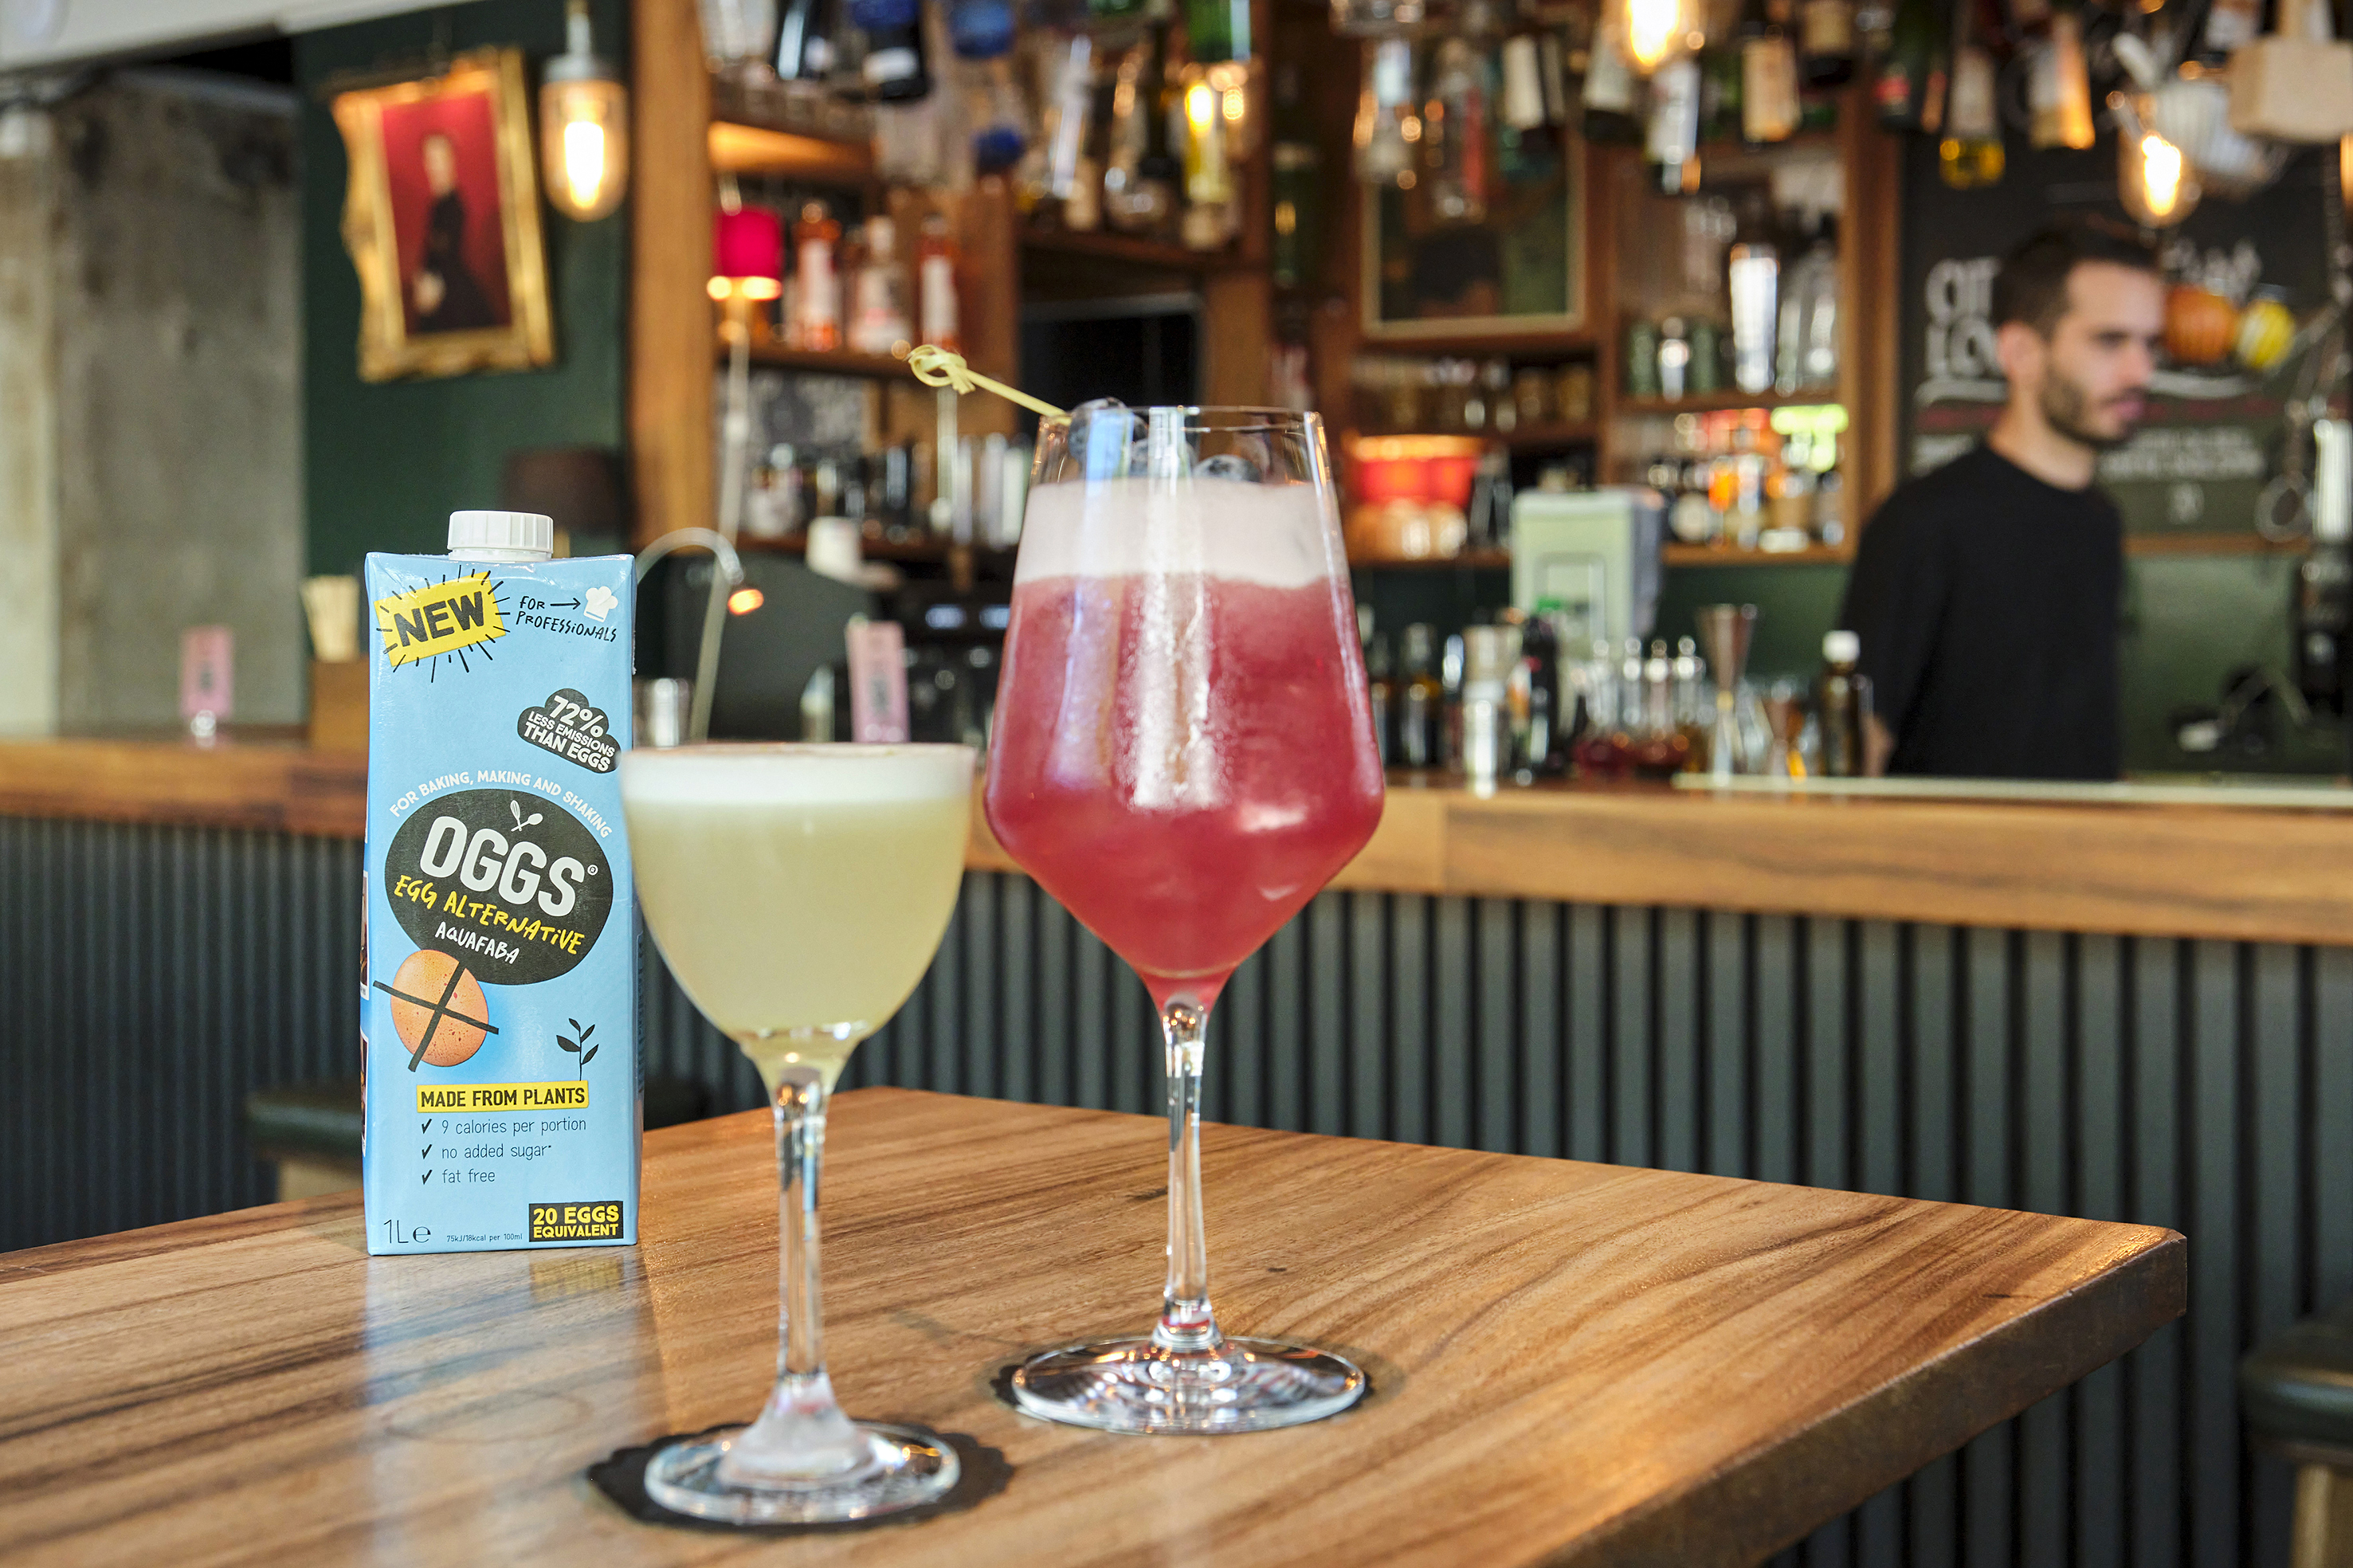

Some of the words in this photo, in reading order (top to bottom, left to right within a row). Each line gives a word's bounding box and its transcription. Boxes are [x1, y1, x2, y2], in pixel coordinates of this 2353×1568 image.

[520, 595, 545, 610] FOR
[394, 591, 484, 647] NEW
[549, 695, 604, 738] 72%
[527, 711, 555, 730] LESS
[555, 723, 615, 757] EMISSIONS
[524, 722, 567, 752] THAN
[567, 742, 611, 771] EGGS
[389, 790, 419, 817] FOR
[418, 771, 473, 797] BAKING,
[477, 770, 531, 786] MAKING
[533, 777, 562, 796] AND
[563, 790, 613, 838] SHAKING
[394, 874, 437, 909] EGG
[434, 921, 520, 964] AQUAFABA
[421, 1091, 466, 1107] MADE
[473, 1089, 517, 1106] FROM
[524, 1087, 586, 1105] PLANTS
[441, 1119, 449, 1135] 9
[455, 1119, 507, 1135] calories
[512, 1121, 535, 1136] per
[541, 1116, 586, 1135] portion
[441, 1147, 457, 1159] no
[464, 1143, 504, 1158] added
[441, 1168, 461, 1184] fat
[468, 1168, 496, 1183] free
[533, 1207, 558, 1225] 20
[564, 1205, 620, 1224] EGGS
[489, 1234, 500, 1243] per
[533, 1223, 619, 1239] EQUIVALENT
